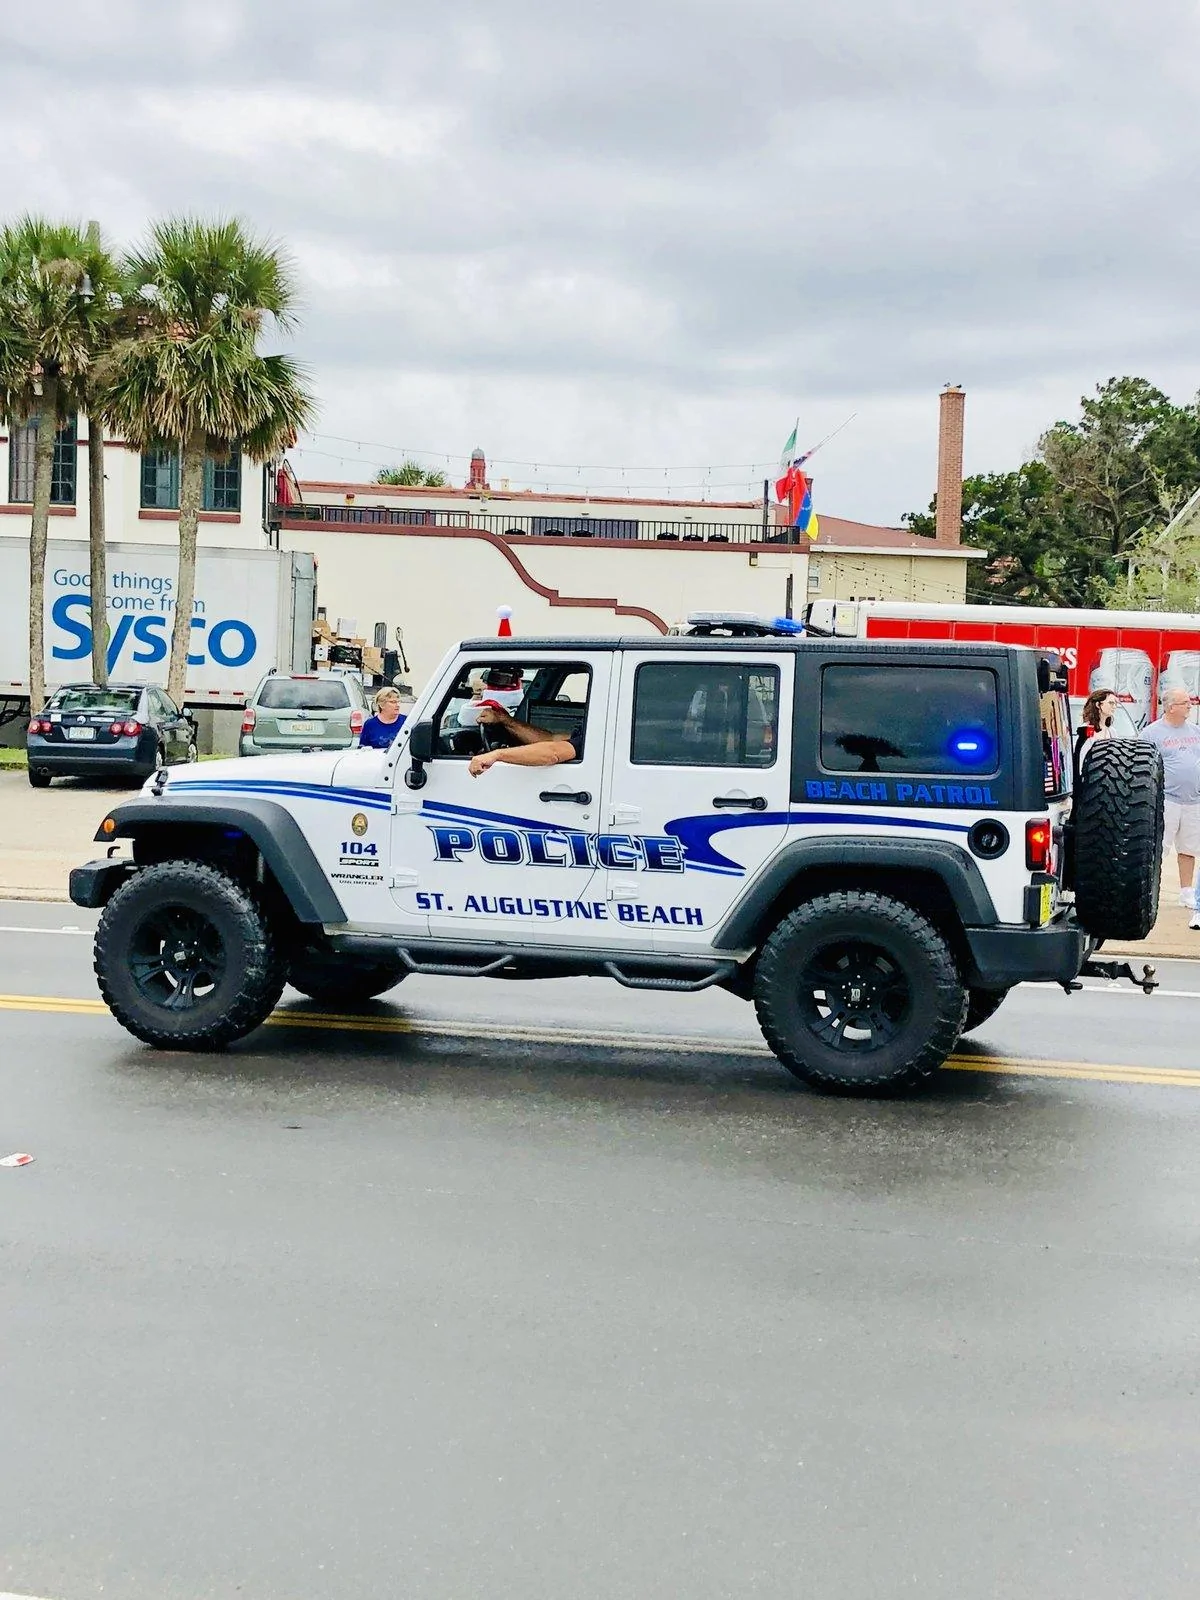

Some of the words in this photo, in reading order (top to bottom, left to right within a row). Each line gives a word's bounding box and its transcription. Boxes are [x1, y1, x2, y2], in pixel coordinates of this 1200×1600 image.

[53, 569, 93, 587] Goo
[112, 571, 173, 595] things
[104, 594, 155, 611] come
[160, 594, 206, 613] frm
[805, 780, 888, 801] BEACH
[896, 783, 999, 805] PATROL
[341, 841, 378, 856] 104
[426, 825, 686, 873] POLICE
[340, 858, 379, 867] SPORT
[331, 873, 384, 881] WRANGLER
[415, 892, 454, 911] ST.
[464, 895, 609, 921] AUGUSTINE
[617, 903, 704, 926] BEACH
